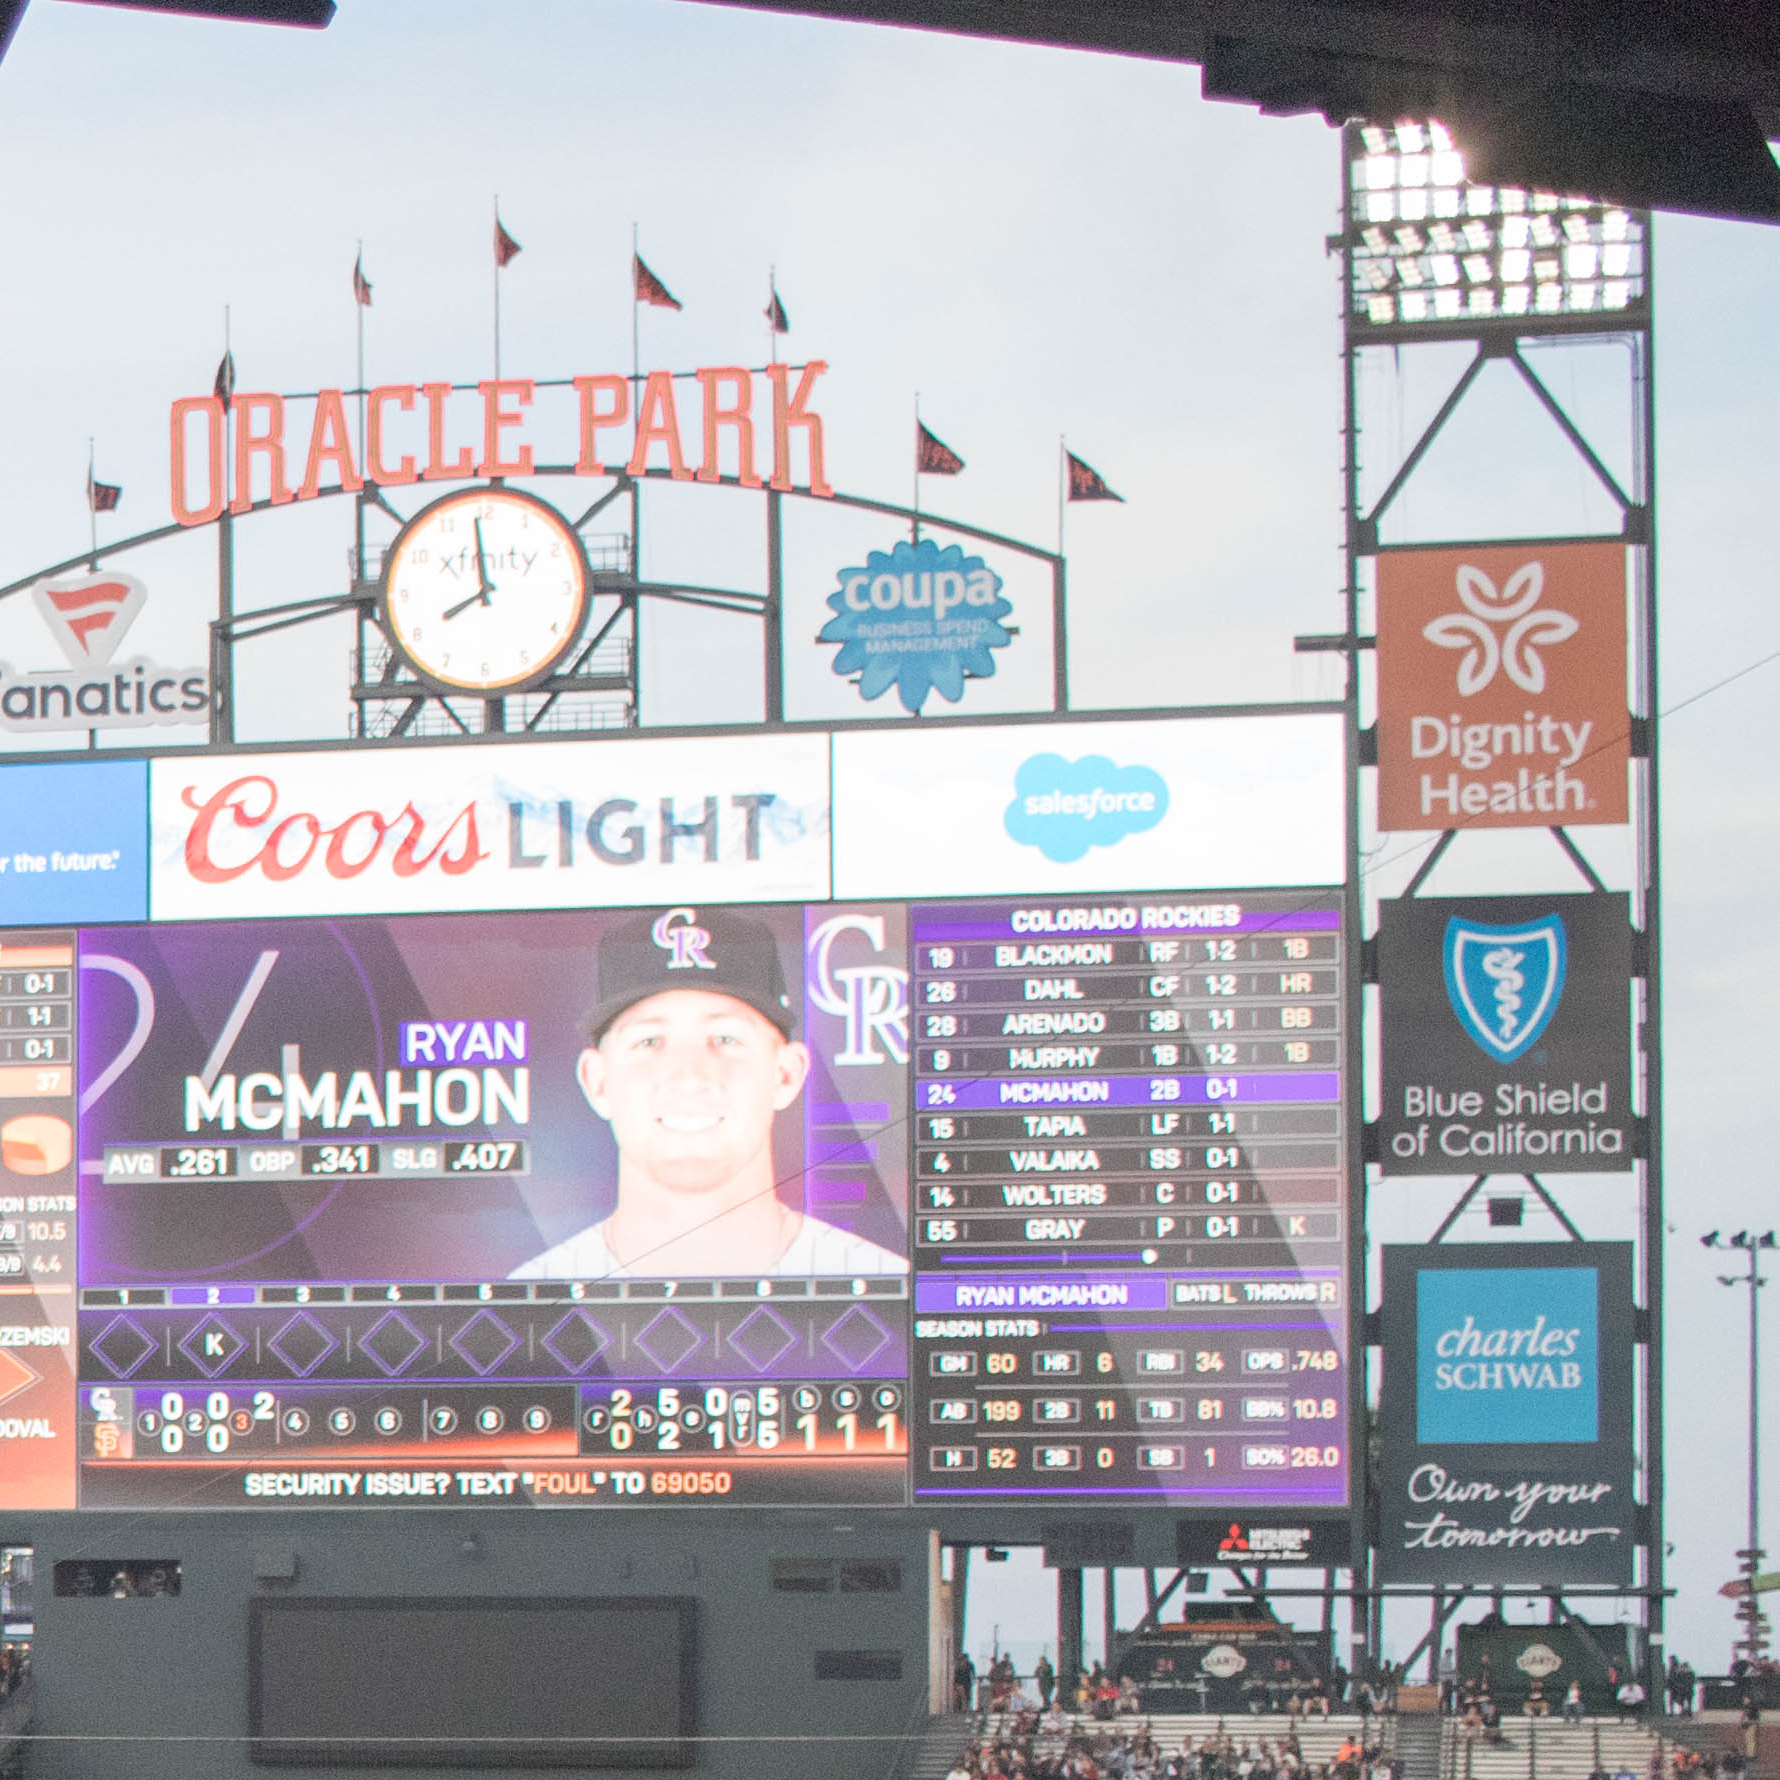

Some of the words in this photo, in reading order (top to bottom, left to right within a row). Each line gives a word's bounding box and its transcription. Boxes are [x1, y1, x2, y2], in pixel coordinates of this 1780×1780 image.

[170, 379, 535, 526] ORACLE
[573, 360, 833, 498] PARK
[843, 568, 998, 619] coupa
[857, 620, 932, 636] BUSINESS
[935, 618, 990, 635] SPEND
[864, 634, 981, 653] MANAGEMENT
[1410, 710, 1593, 771] Dignity
[1025, 787, 1157, 821] salesforce
[1420, 767, 1585, 816] Health
[181, 775, 491, 884] Coors
[507, 793, 777, 870] LIGHT
[14, 851, 47, 873] the
[1011, 908, 1138, 933] COLORADO
[1141, 905, 1241, 929] ROCKIES
[928, 948, 954, 968] 19
[996, 944, 1112, 967] BLACKMON
[1149, 942, 1180, 961] RF
[24, 974, 54, 993] 0-1
[1024, 979, 1084, 1000] DAHL
[1149, 975, 1180, 996] CF
[1279, 972, 1312, 994] HR
[1002, 1011, 1106, 1034] ARENADO
[1150, 1010, 1181, 1031] 3B
[1280, 1006, 1311, 1027] BB
[24, 1038, 54, 1058] 0-1
[405, 1022, 526, 1064] RYAN
[1009, 1047, 1100, 1069] MURPHY
[36, 1073, 60, 1091] 37
[927, 1084, 956, 1105] 24
[999, 1080, 1109, 1103] MCMAHON
[1149, 1079, 1181, 1099] 2B
[1206, 1077, 1238, 1098] 0-1
[184, 1067, 531, 1132] MCMAHON
[1404, 1085, 1484, 1118] Blue
[1495, 1080, 1609, 1116] Shield
[929, 1118, 954, 1138] 15
[1024, 1115, 1087, 1137] TAPIA
[1151, 1113, 1180, 1134] LF
[1390, 1123, 1430, 1157] of
[1439, 1121, 1624, 1156] California
[107, 1151, 155, 1178] AVG
[170, 1148, 228, 1178] .261
[249, 1148, 296, 1173] OBP
[312, 1145, 371, 1174] .341
[391, 1146, 438, 1170] SLG
[452, 1143, 514, 1171] .407
[1009, 1149, 1100, 1172] VALAIKA
[1149, 1148, 1181, 1169] SS
[27, 1195, 77, 1213] STATS
[1002, 1184, 1108, 1206] WOLTERS
[27, 1222, 66, 1242] 10.5
[927, 1219, 958, 1241] 55
[1024, 1218, 1086, 1241] GRAY
[32, 1254, 63, 1273] 4.4
[955, 1286, 1015, 1308] RYAN
[1019, 1284, 1128, 1306] MCMAHON
[915, 1320, 983, 1338] SEASON
[984, 1319, 1039, 1337] STATS
[1435, 1315, 1581, 1357] charles
[1435, 1362, 1583, 1390] SCHWAB
[245, 1472, 361, 1496] SECURITY
[365, 1472, 450, 1495] ISSUE?
[456, 1472, 518, 1495] TEXT
[522, 1471, 605, 1495] "FOUL"
[610, 1471, 645, 1494] TO
[651, 1471, 732, 1494] 69050
[1407, 1463, 1501, 1503] Own
[1505, 1481, 1612, 1524] your
[1404, 1512, 1621, 1549] tomorrow
